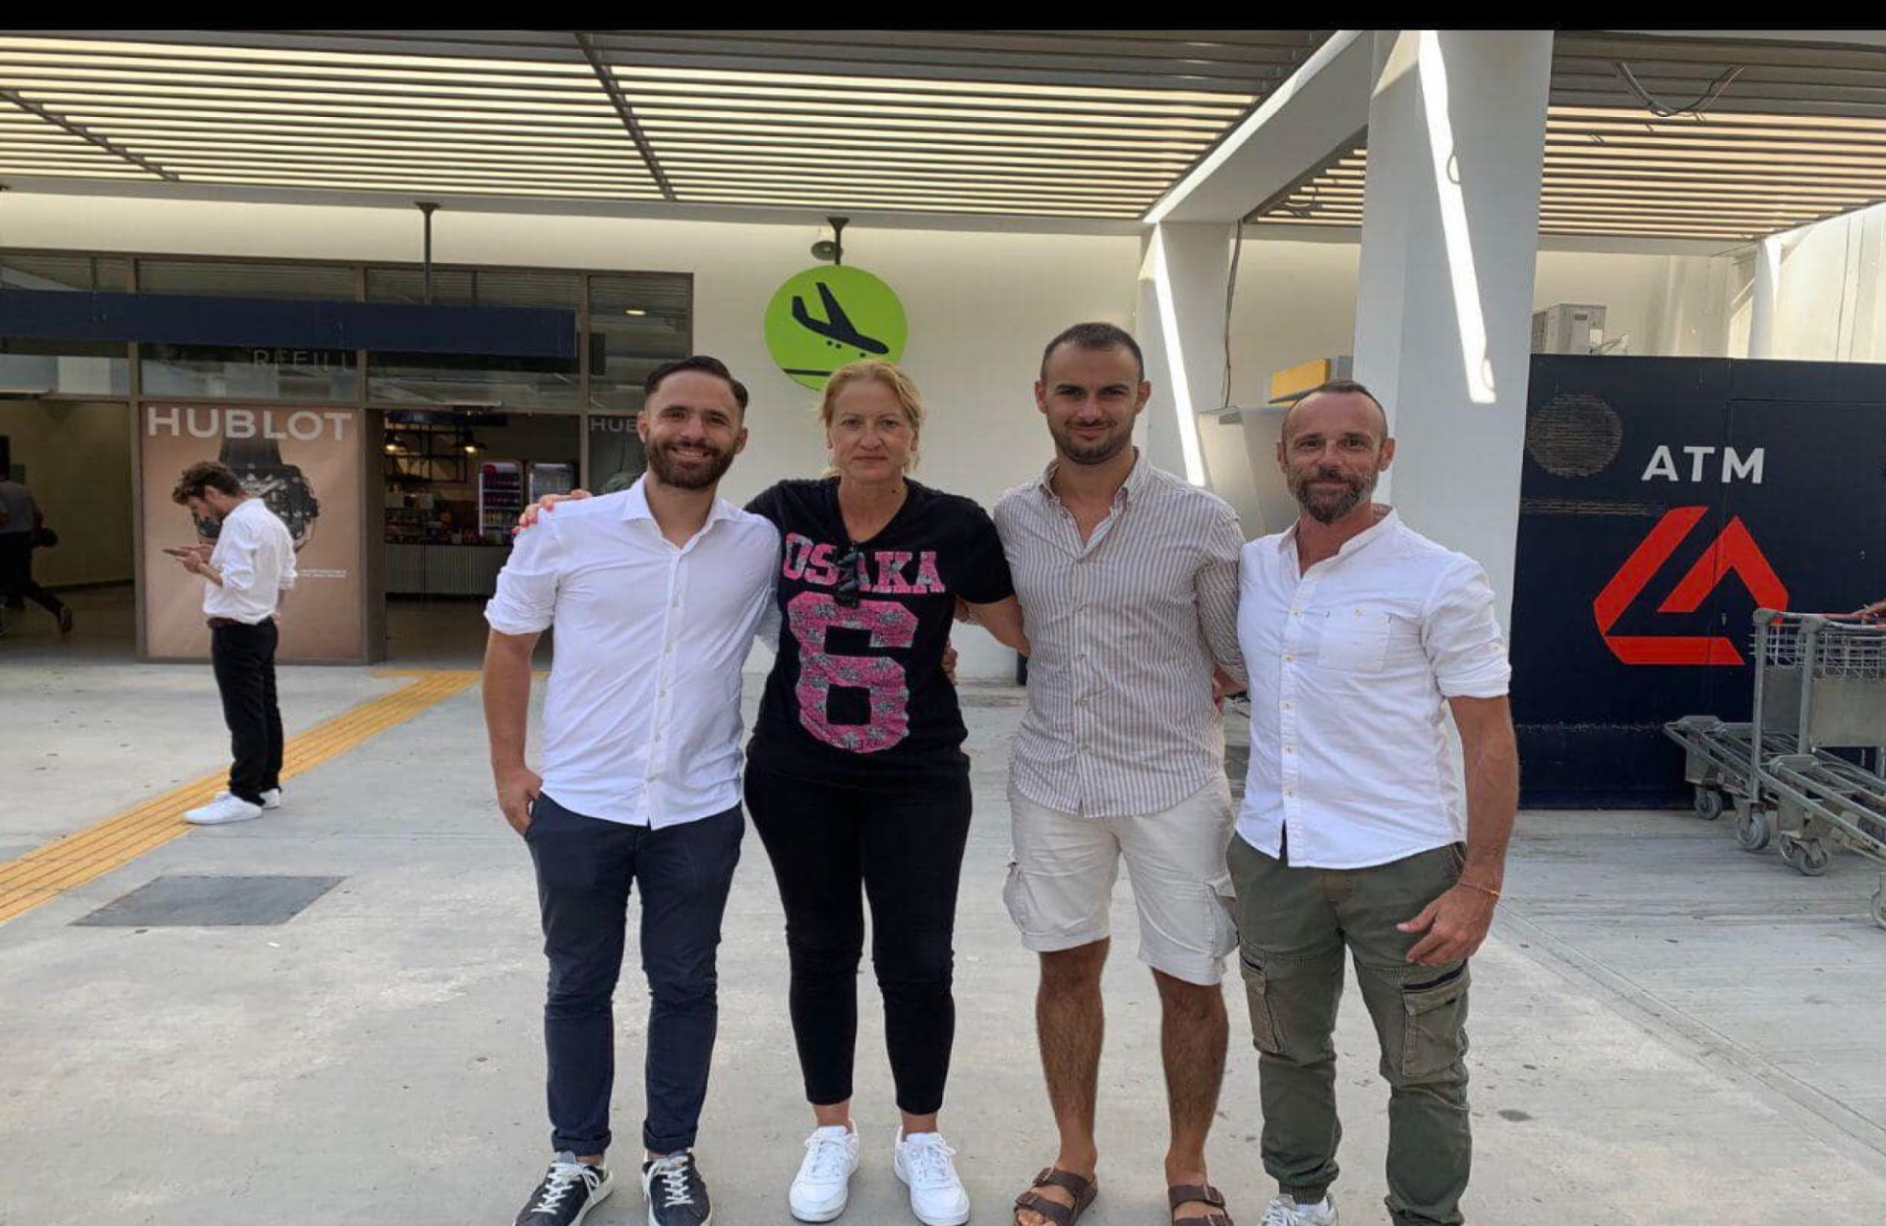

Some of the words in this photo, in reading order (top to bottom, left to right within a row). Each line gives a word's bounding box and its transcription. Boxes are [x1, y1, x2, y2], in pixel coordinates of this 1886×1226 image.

[147, 406, 353, 441] HUBLOT
[1641, 445, 1765, 485] ATM
[787, 591, 919, 754] 6
